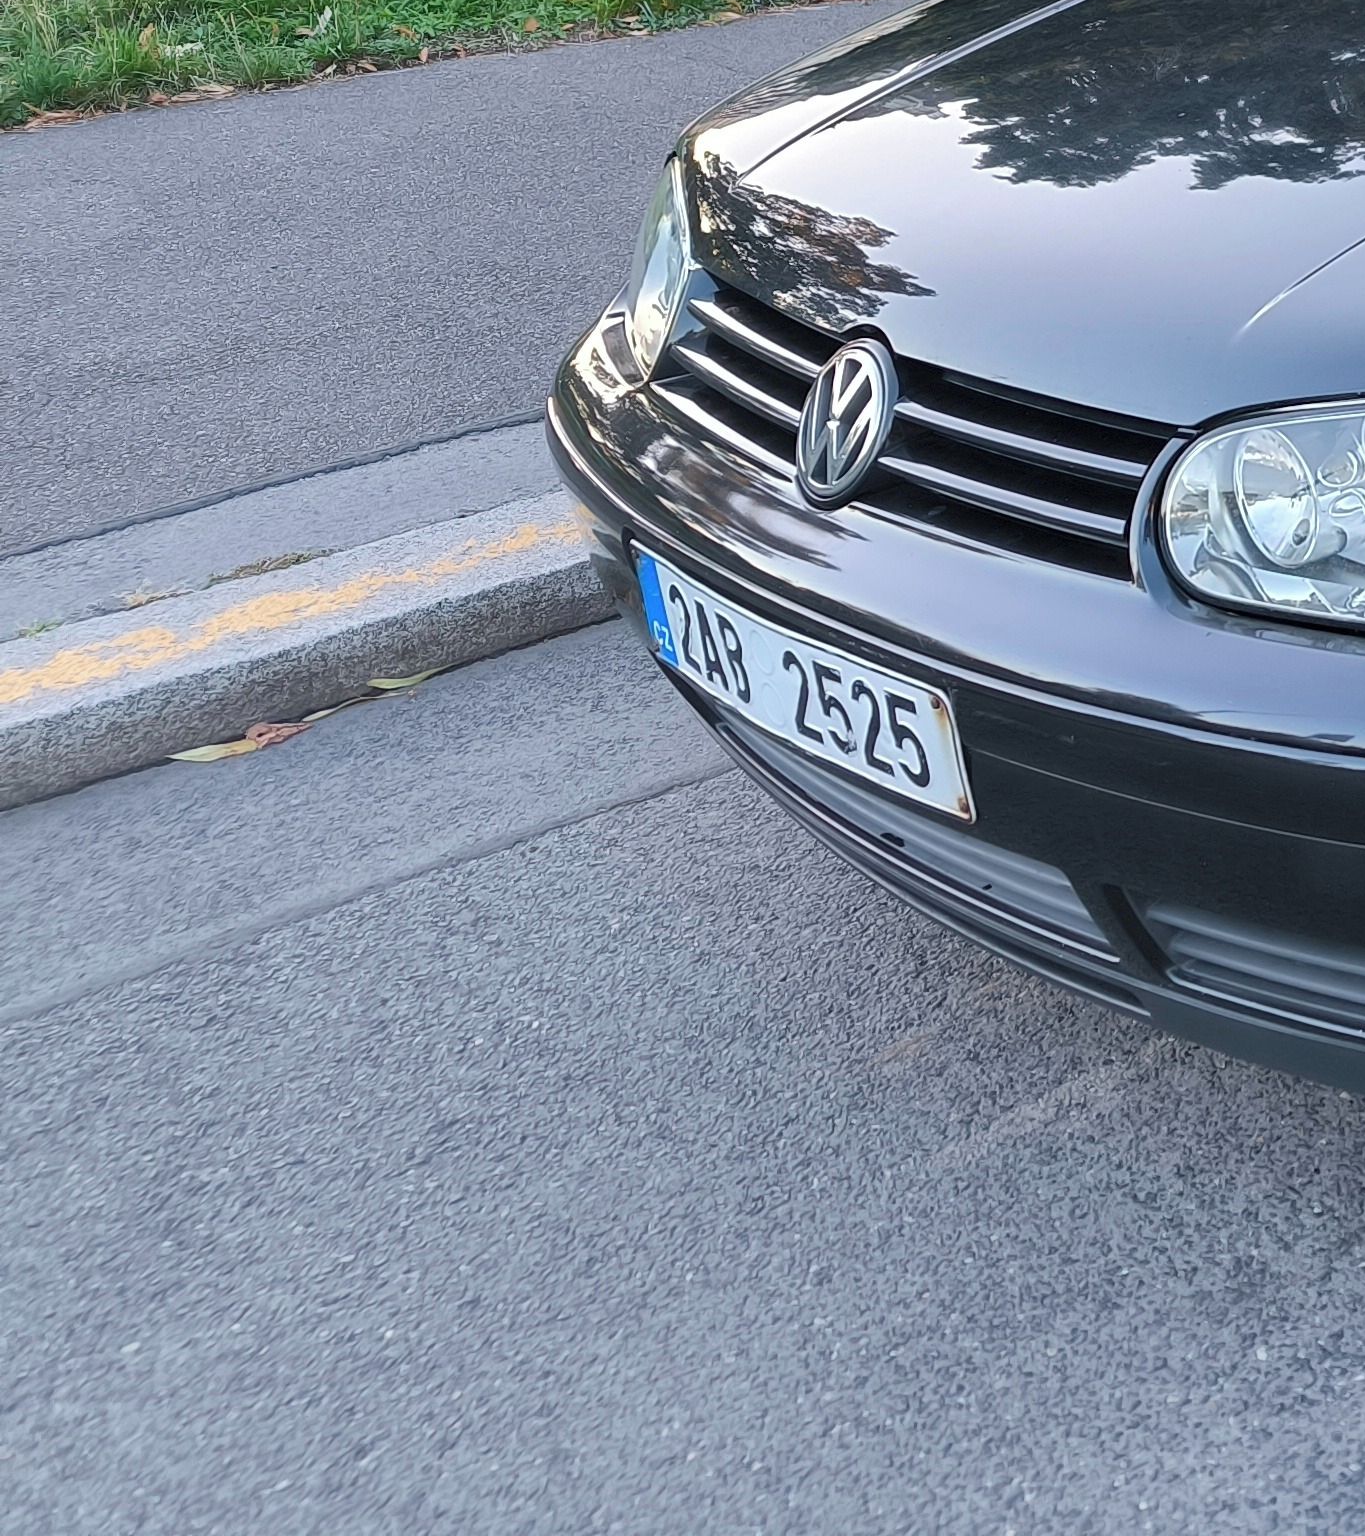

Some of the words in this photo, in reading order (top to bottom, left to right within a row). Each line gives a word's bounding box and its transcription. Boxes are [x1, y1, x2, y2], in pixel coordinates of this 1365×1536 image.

[653, 620, 673, 652] CZ
[669, 584, 750, 704] 2AB
[782, 650, 931, 788] 2525
